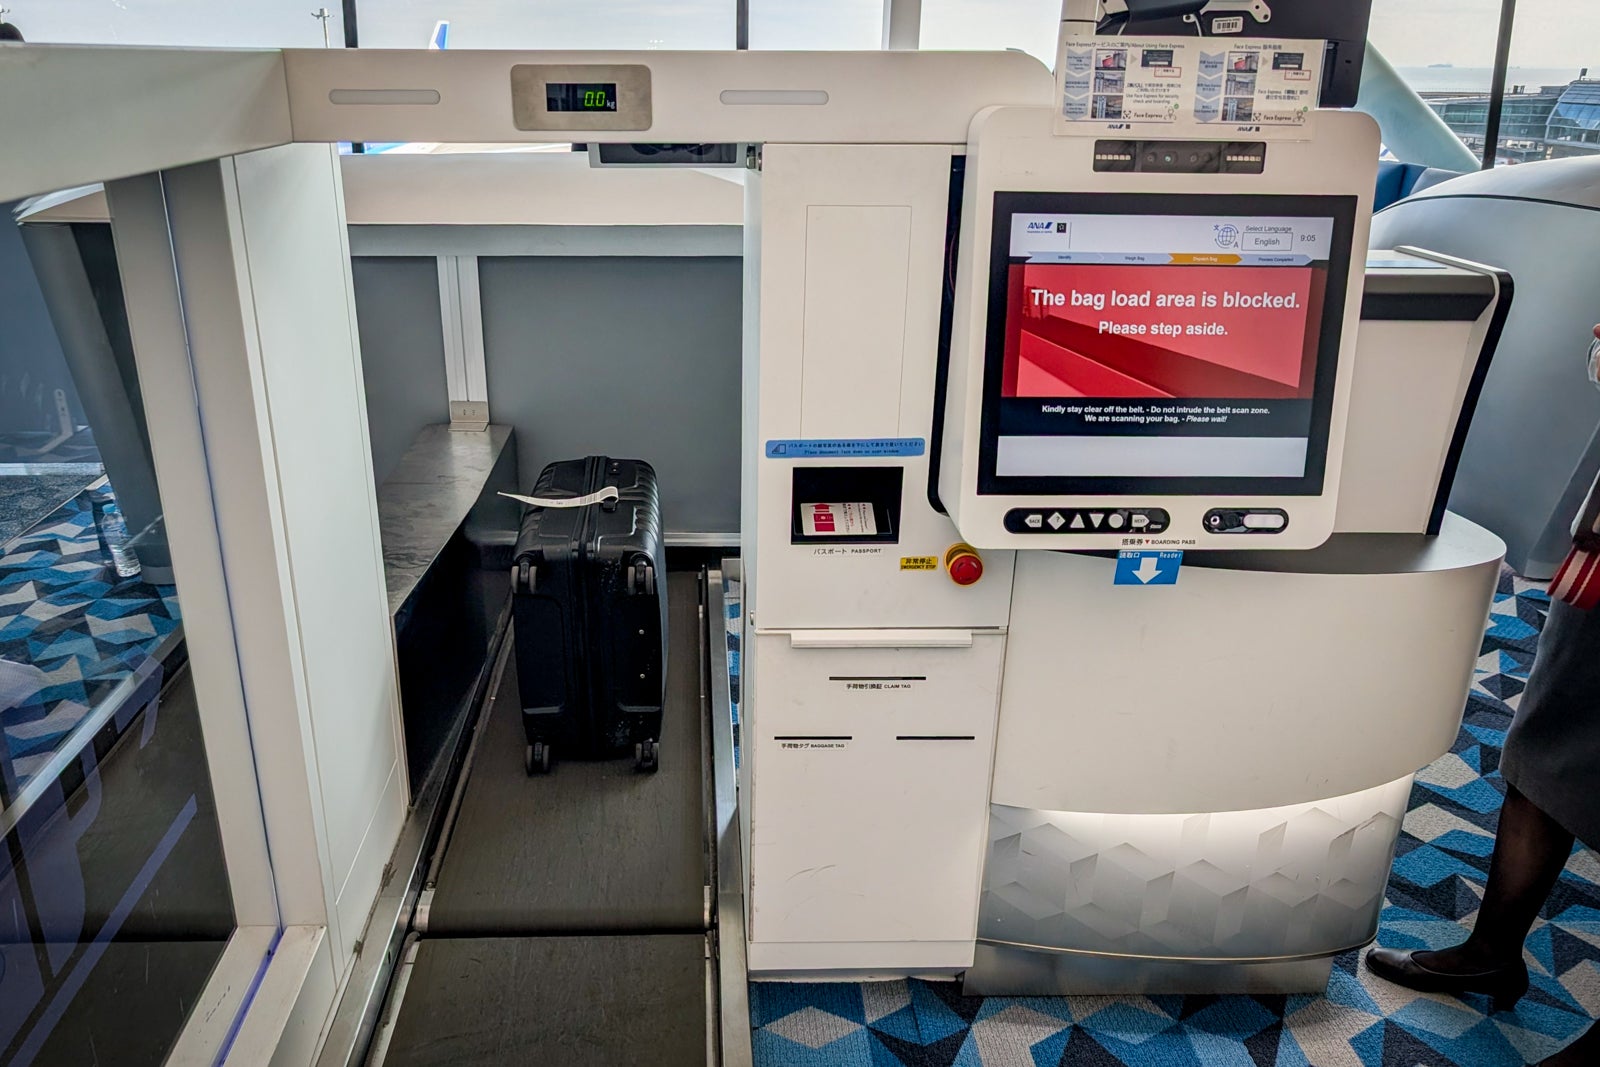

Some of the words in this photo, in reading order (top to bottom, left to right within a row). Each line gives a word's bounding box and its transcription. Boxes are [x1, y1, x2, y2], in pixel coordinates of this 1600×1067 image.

[584, 91, 606, 106] 0.0
[606, 100, 616, 110] kg
[1254, 238, 1280, 246] English
[1031, 289, 1065, 306] The
[1070, 290, 1106, 310] bag
[1110, 290, 1150, 307] load
[1156, 294, 1196, 308] area
[1202, 291, 1217, 308] is
[1222, 292, 1300, 308] blocked.
[1098, 320, 1146, 334] Please
[1150, 323, 1182, 338] step
[1186, 322, 1228, 336] aside.
[1042, 405, 1066, 414] Kindly
[1067, 406, 1083, 414] stay
[1111, 415, 1145, 424] scanning
[1164, 415, 1180, 424] bag.
